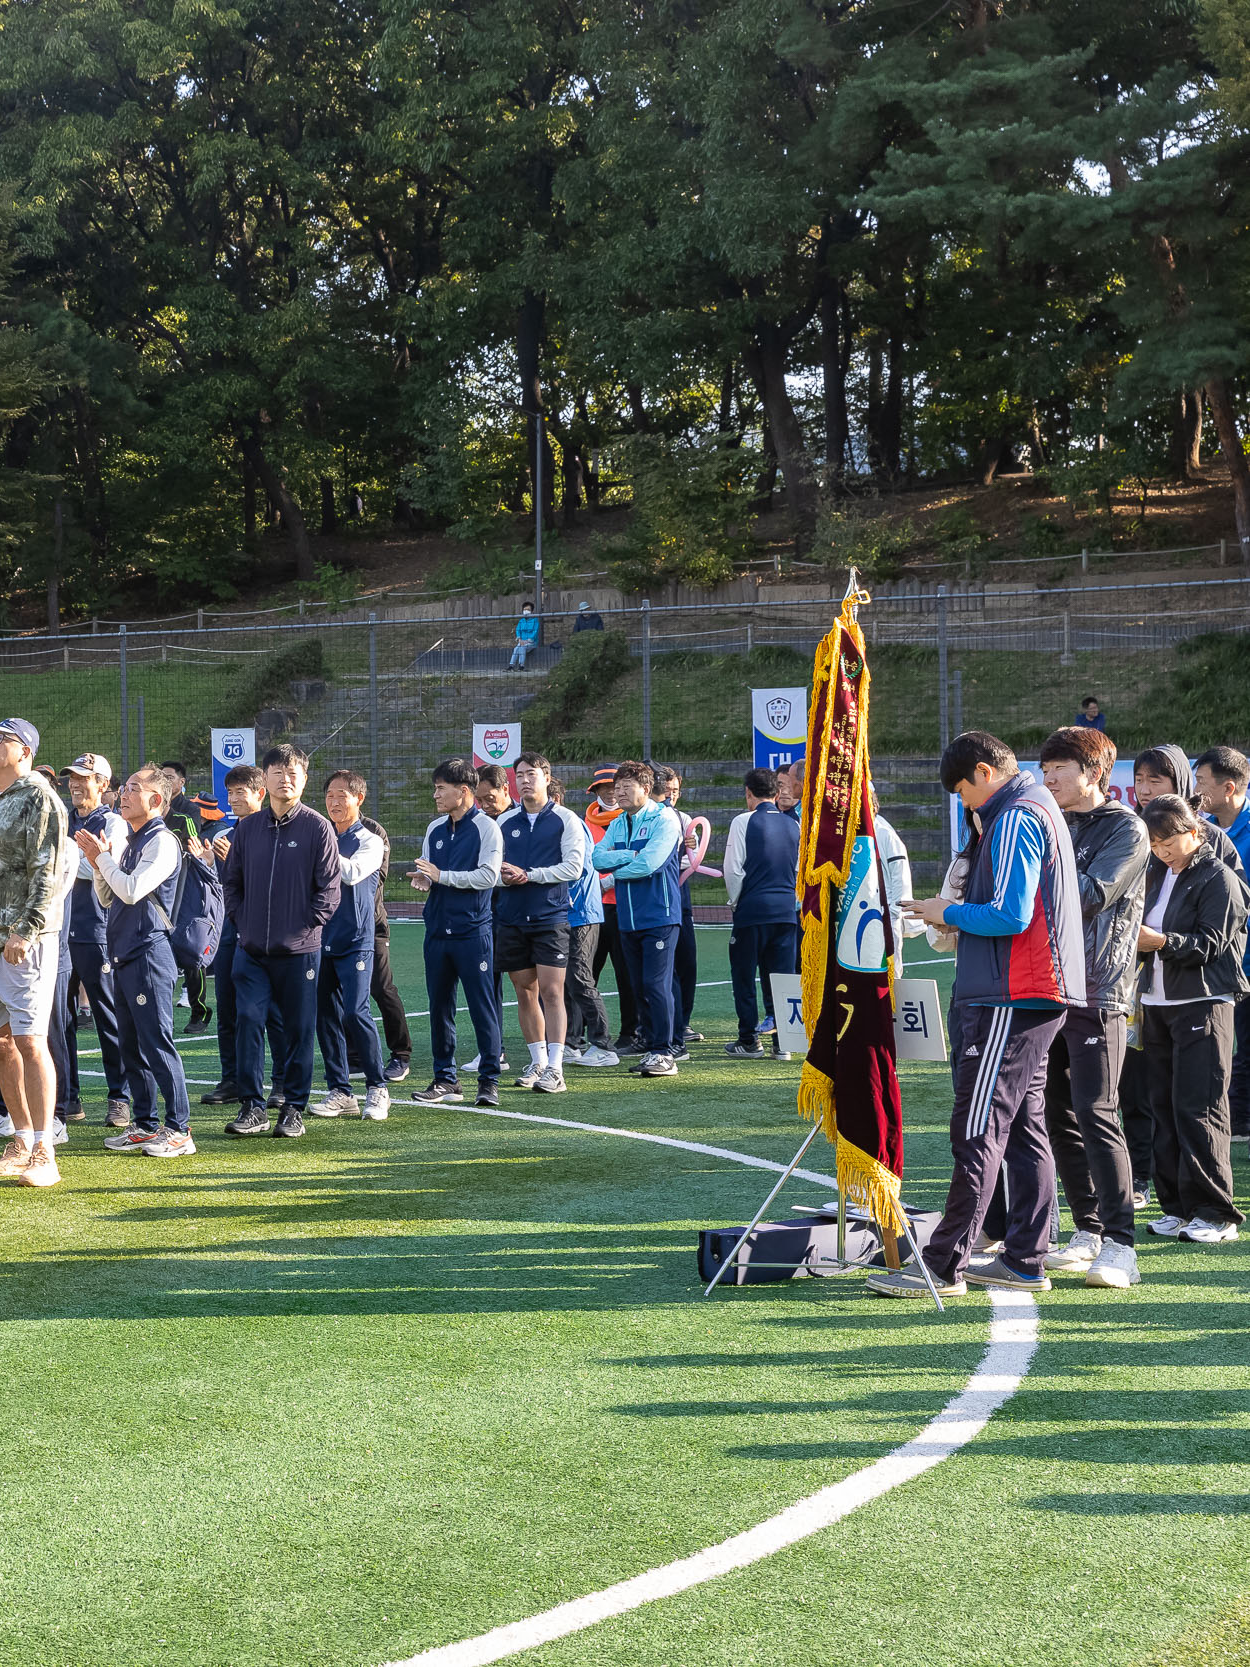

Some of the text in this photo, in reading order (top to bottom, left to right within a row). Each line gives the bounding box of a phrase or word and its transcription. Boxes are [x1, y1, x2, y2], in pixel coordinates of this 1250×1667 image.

[227, 745, 240, 756] JG
[1084, 1036, 1099, 1045] NB
[891, 1287, 926, 1297] crocs
